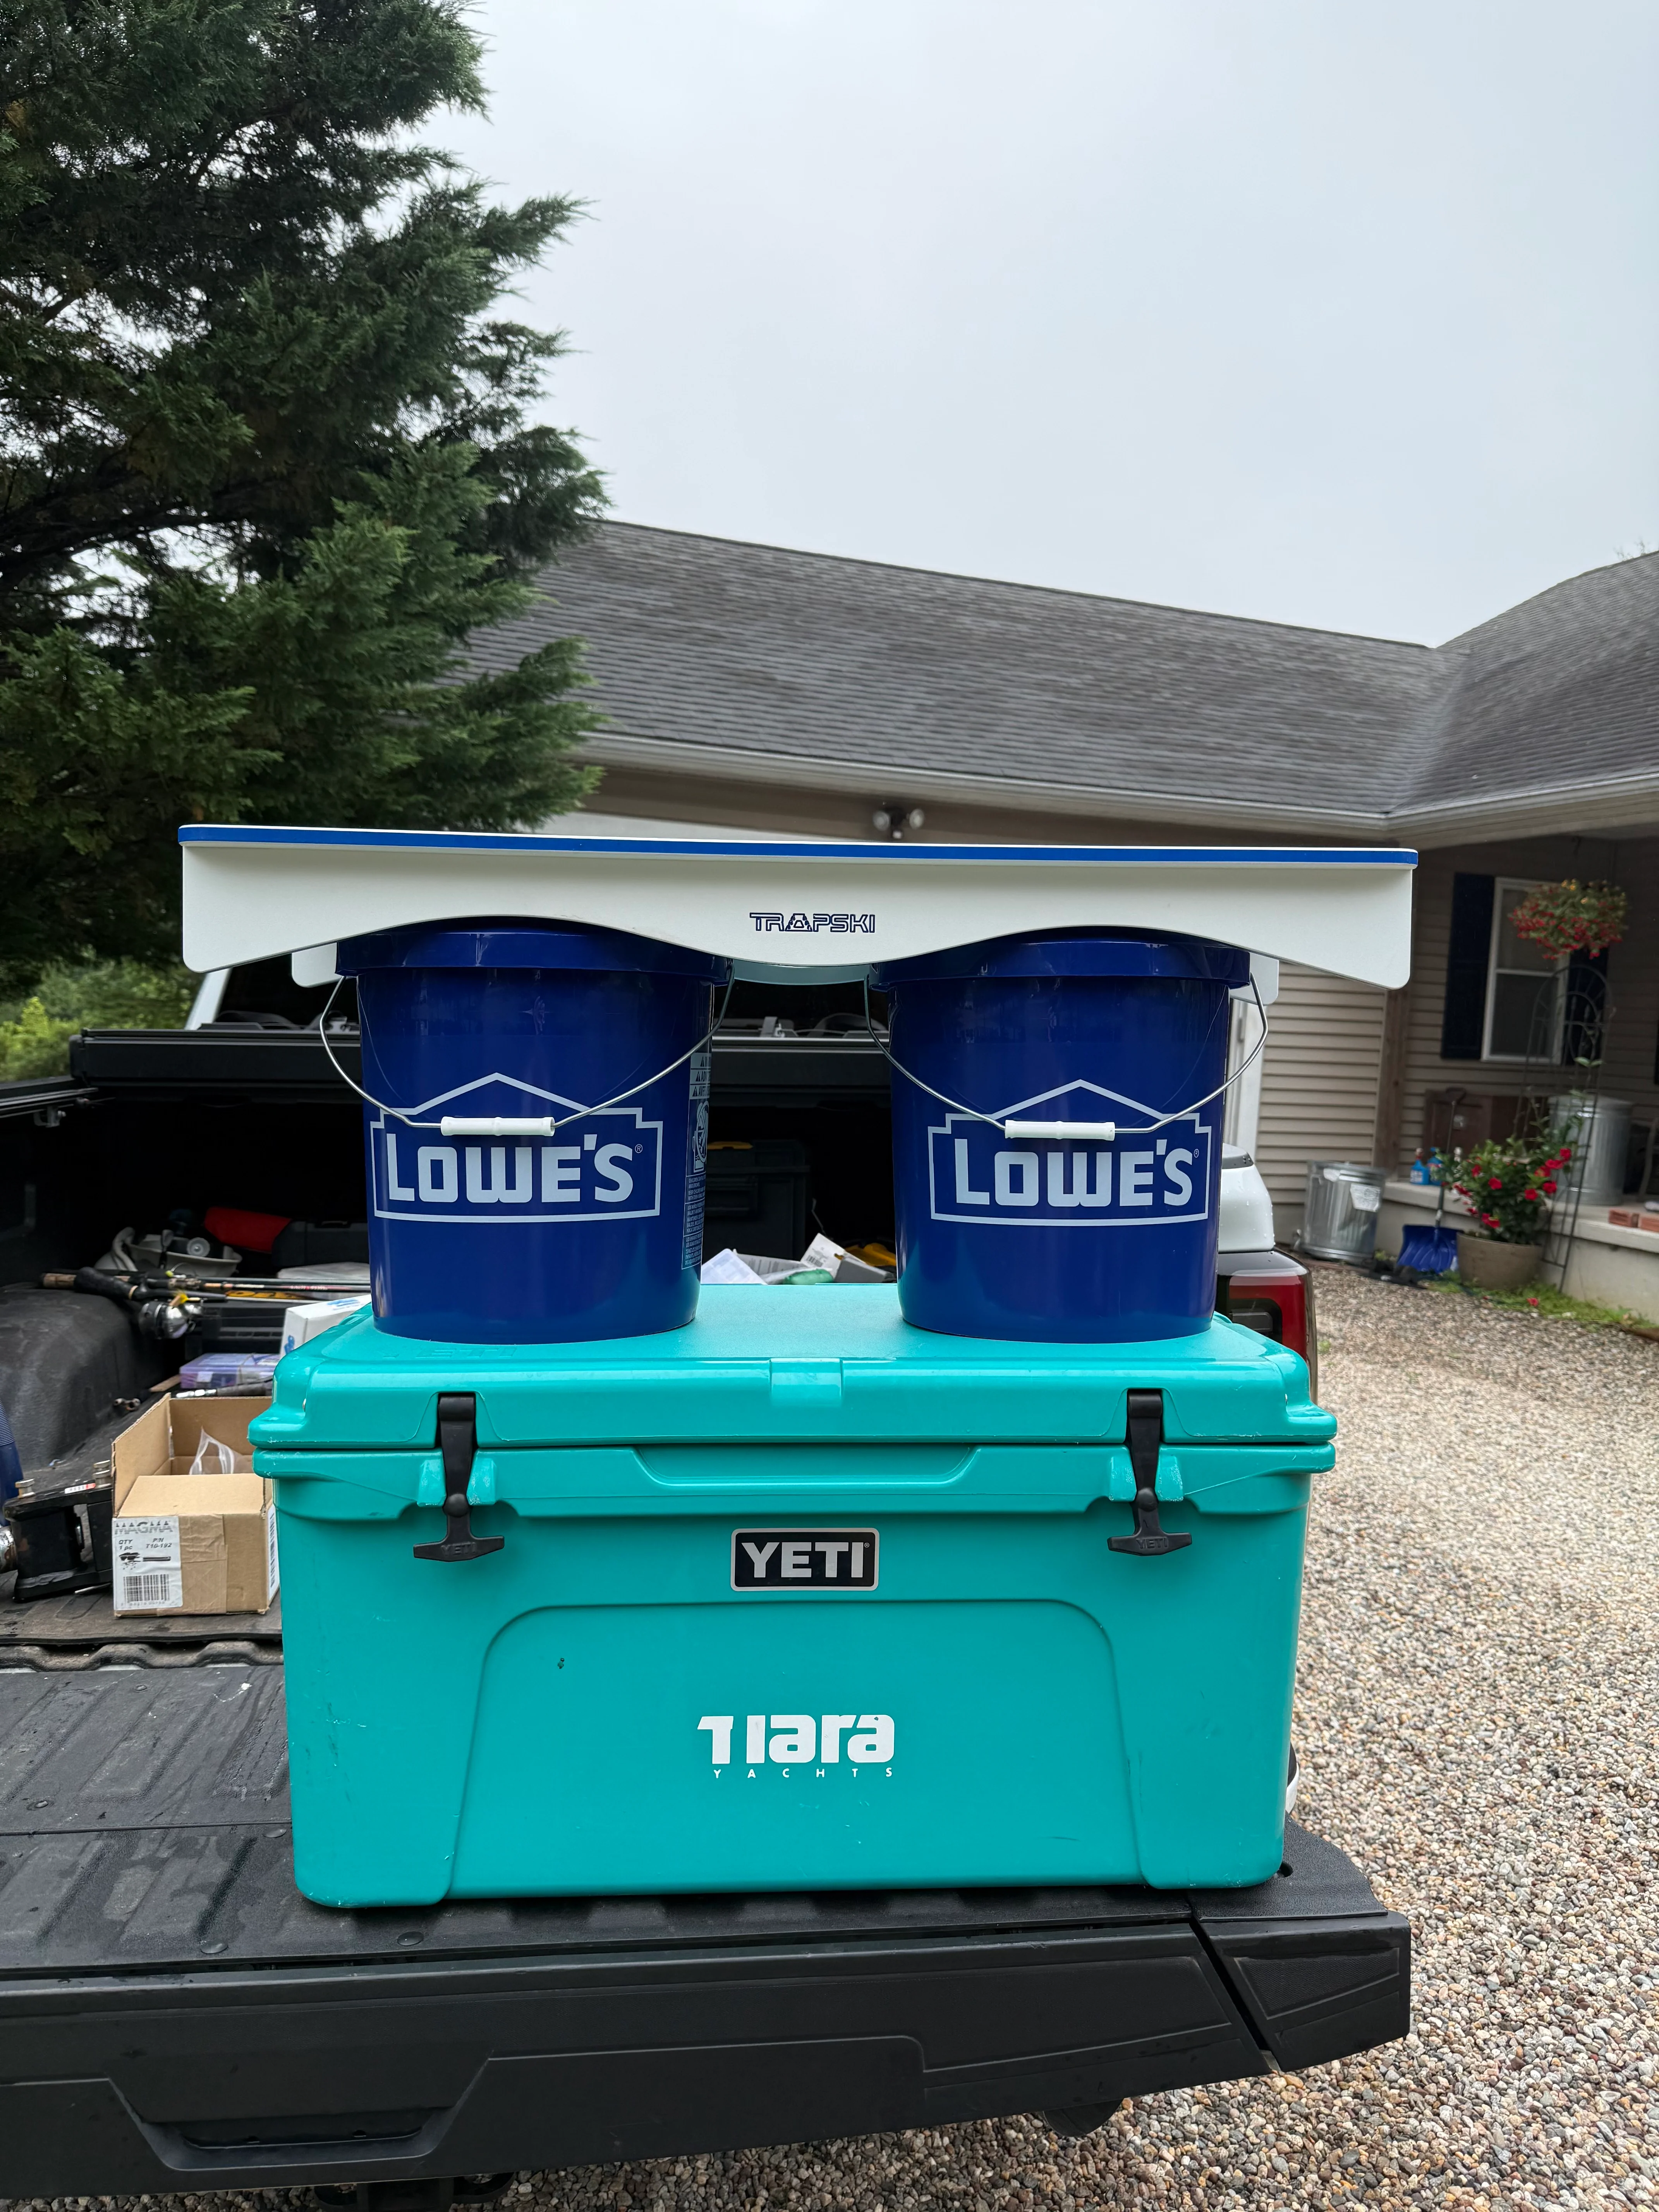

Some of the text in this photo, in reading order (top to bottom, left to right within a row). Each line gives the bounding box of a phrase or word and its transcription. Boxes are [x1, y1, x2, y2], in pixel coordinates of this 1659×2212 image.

[749, 912, 876, 933] TRAPSKI
[386, 1133, 634, 1203] LOWE'S
[954, 1139, 1193, 1207] LOWE'S
[115, 1520, 173, 1535] MAGMA
[441, 1542, 476, 1556] YETI
[1136, 1536, 1169, 1549] YETI
[741, 1542, 864, 1578] YETI
[713, 1767, 892, 1779] YACHTS
